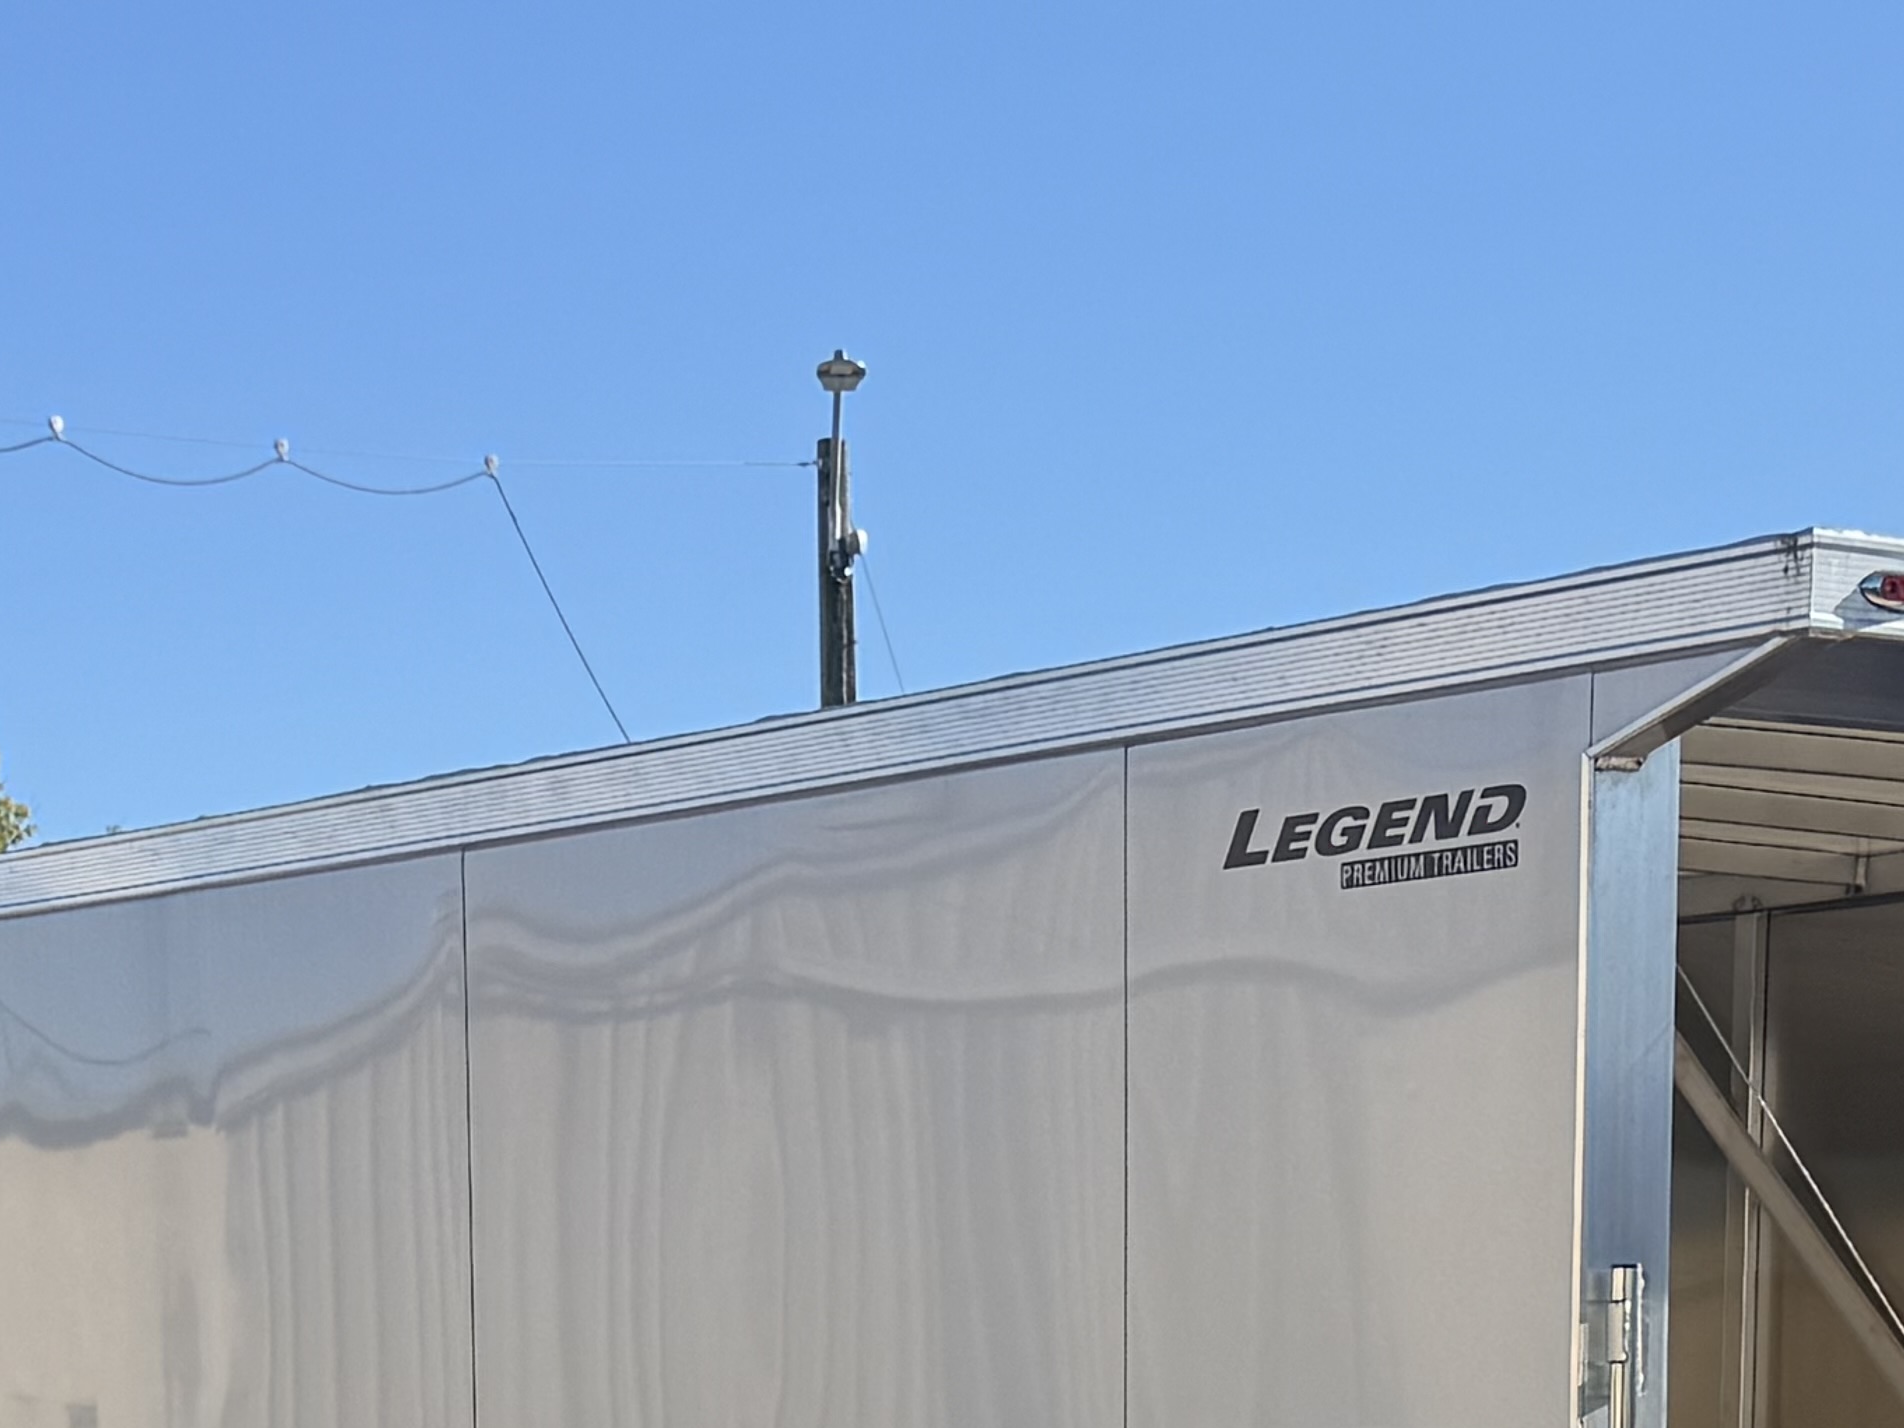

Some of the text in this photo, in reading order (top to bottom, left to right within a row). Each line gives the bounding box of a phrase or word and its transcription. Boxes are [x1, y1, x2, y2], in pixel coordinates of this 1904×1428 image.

[1222, 783, 1528, 871] LEGEND
[1342, 842, 1517, 888] PREMIUM TRAILERS
